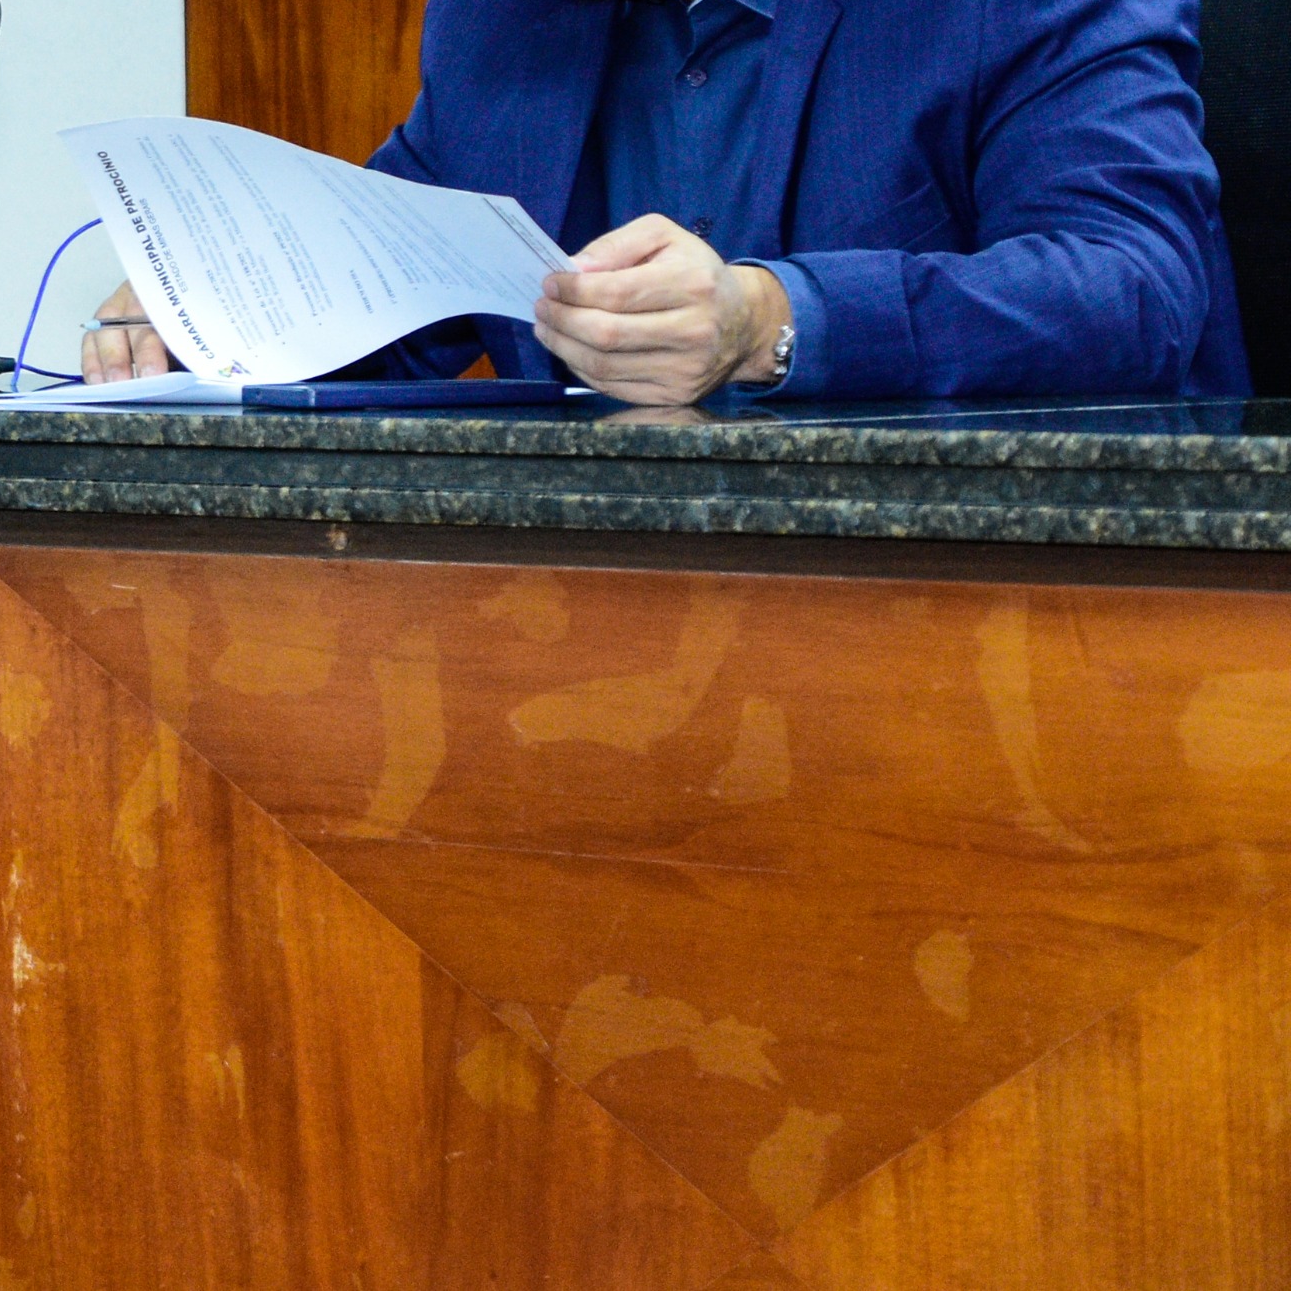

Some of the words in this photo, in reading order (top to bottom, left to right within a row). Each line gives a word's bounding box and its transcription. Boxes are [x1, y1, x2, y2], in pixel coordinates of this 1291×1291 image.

[97, 150, 138, 215] PATROCÍNIO
[131, 216, 147, 234] DE
[138, 197, 157, 225] GERAIS
[151, 224, 168, 250] MINAS
[162, 248, 173, 261] DE
[142, 235, 181, 306] MUNICIPAL
[168, 261, 188, 294] ESTADO
[177, 308, 215, 360] CÂMARA
